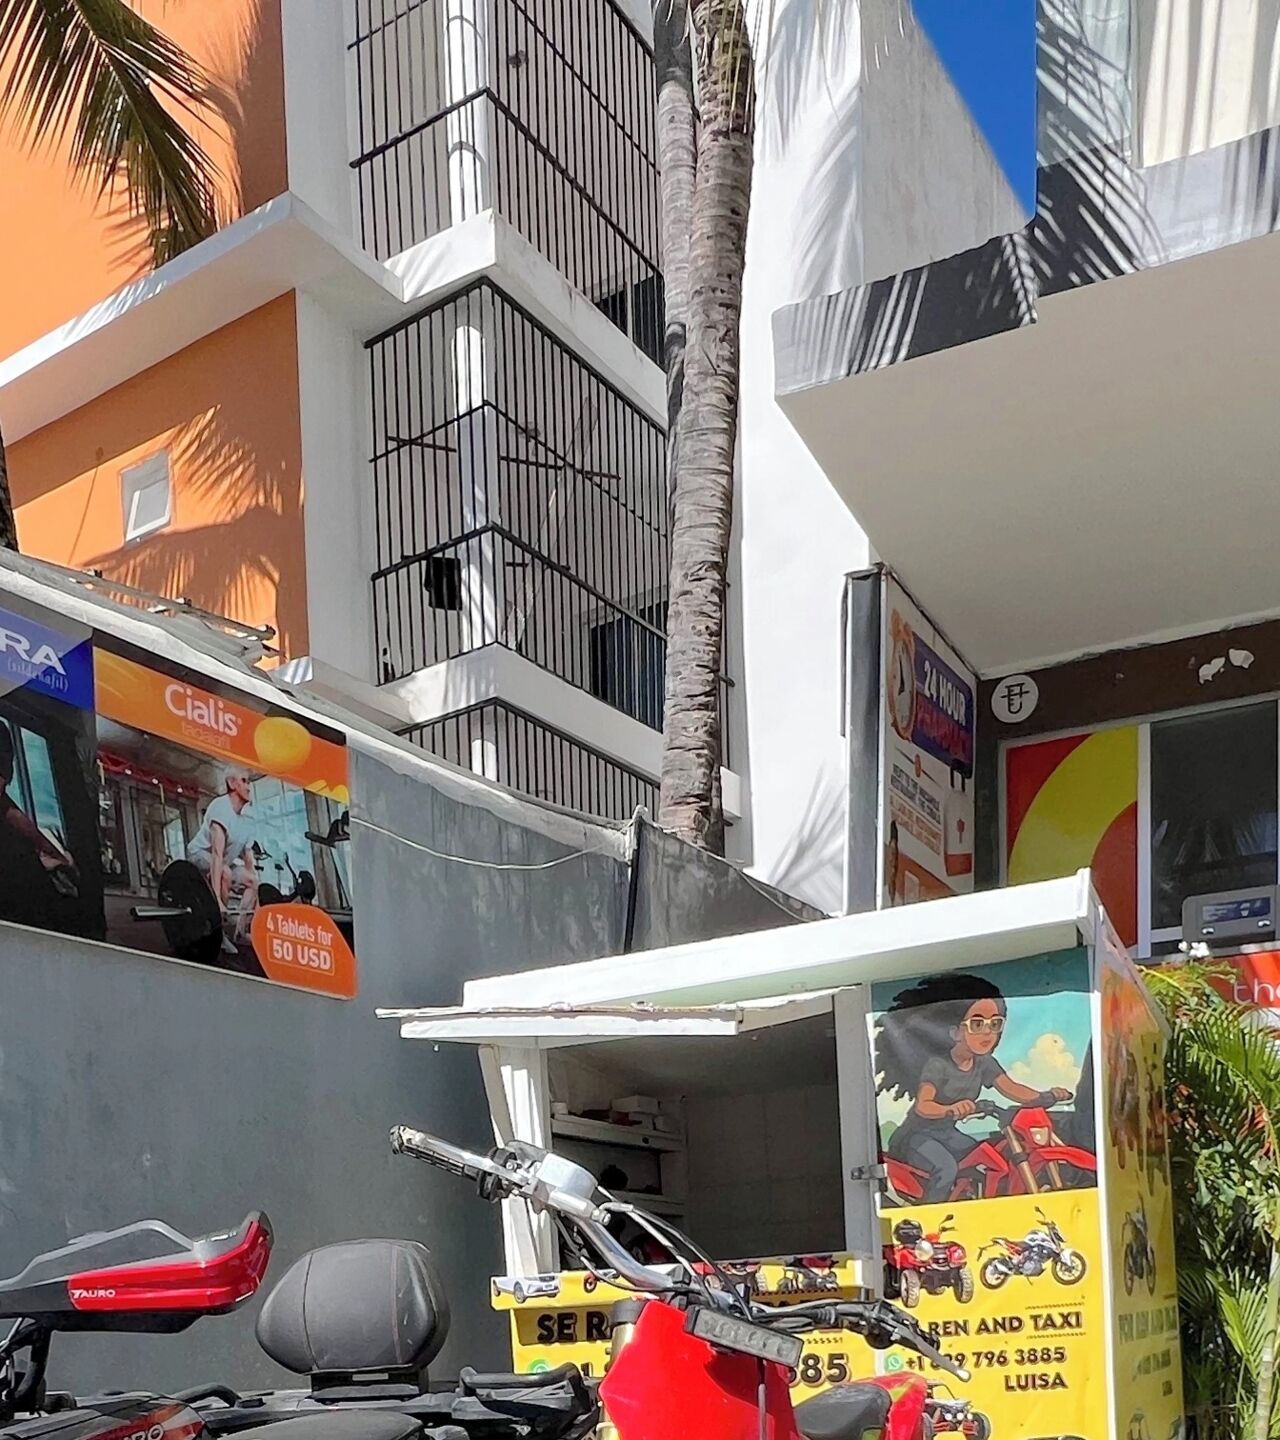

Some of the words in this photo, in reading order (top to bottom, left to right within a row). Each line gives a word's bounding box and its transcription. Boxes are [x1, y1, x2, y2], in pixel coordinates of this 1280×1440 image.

[924, 660, 937, 701] 24
[939, 673, 966, 727] HOUR
[165, 684, 238, 736] Cialis
[266, 912, 274, 931] 4
[276, 914, 314, 942] Tablets
[317, 926, 333, 946] for
[272, 938, 293, 961] 50
[297, 944, 331, 970] USD
[71, 1288, 116, 1299] TAURO
[537, 1312, 577, 1344] SE
[928, 1319, 970, 1337] REN
[975, 1316, 1025, 1336] AND
[1030, 1311, 1083, 1332] TAXI
[972, 1350, 1010, 1369] 796
[1014, 1347, 1067, 1366] 3885
[1004, 1371, 1068, 1392] LUISA
